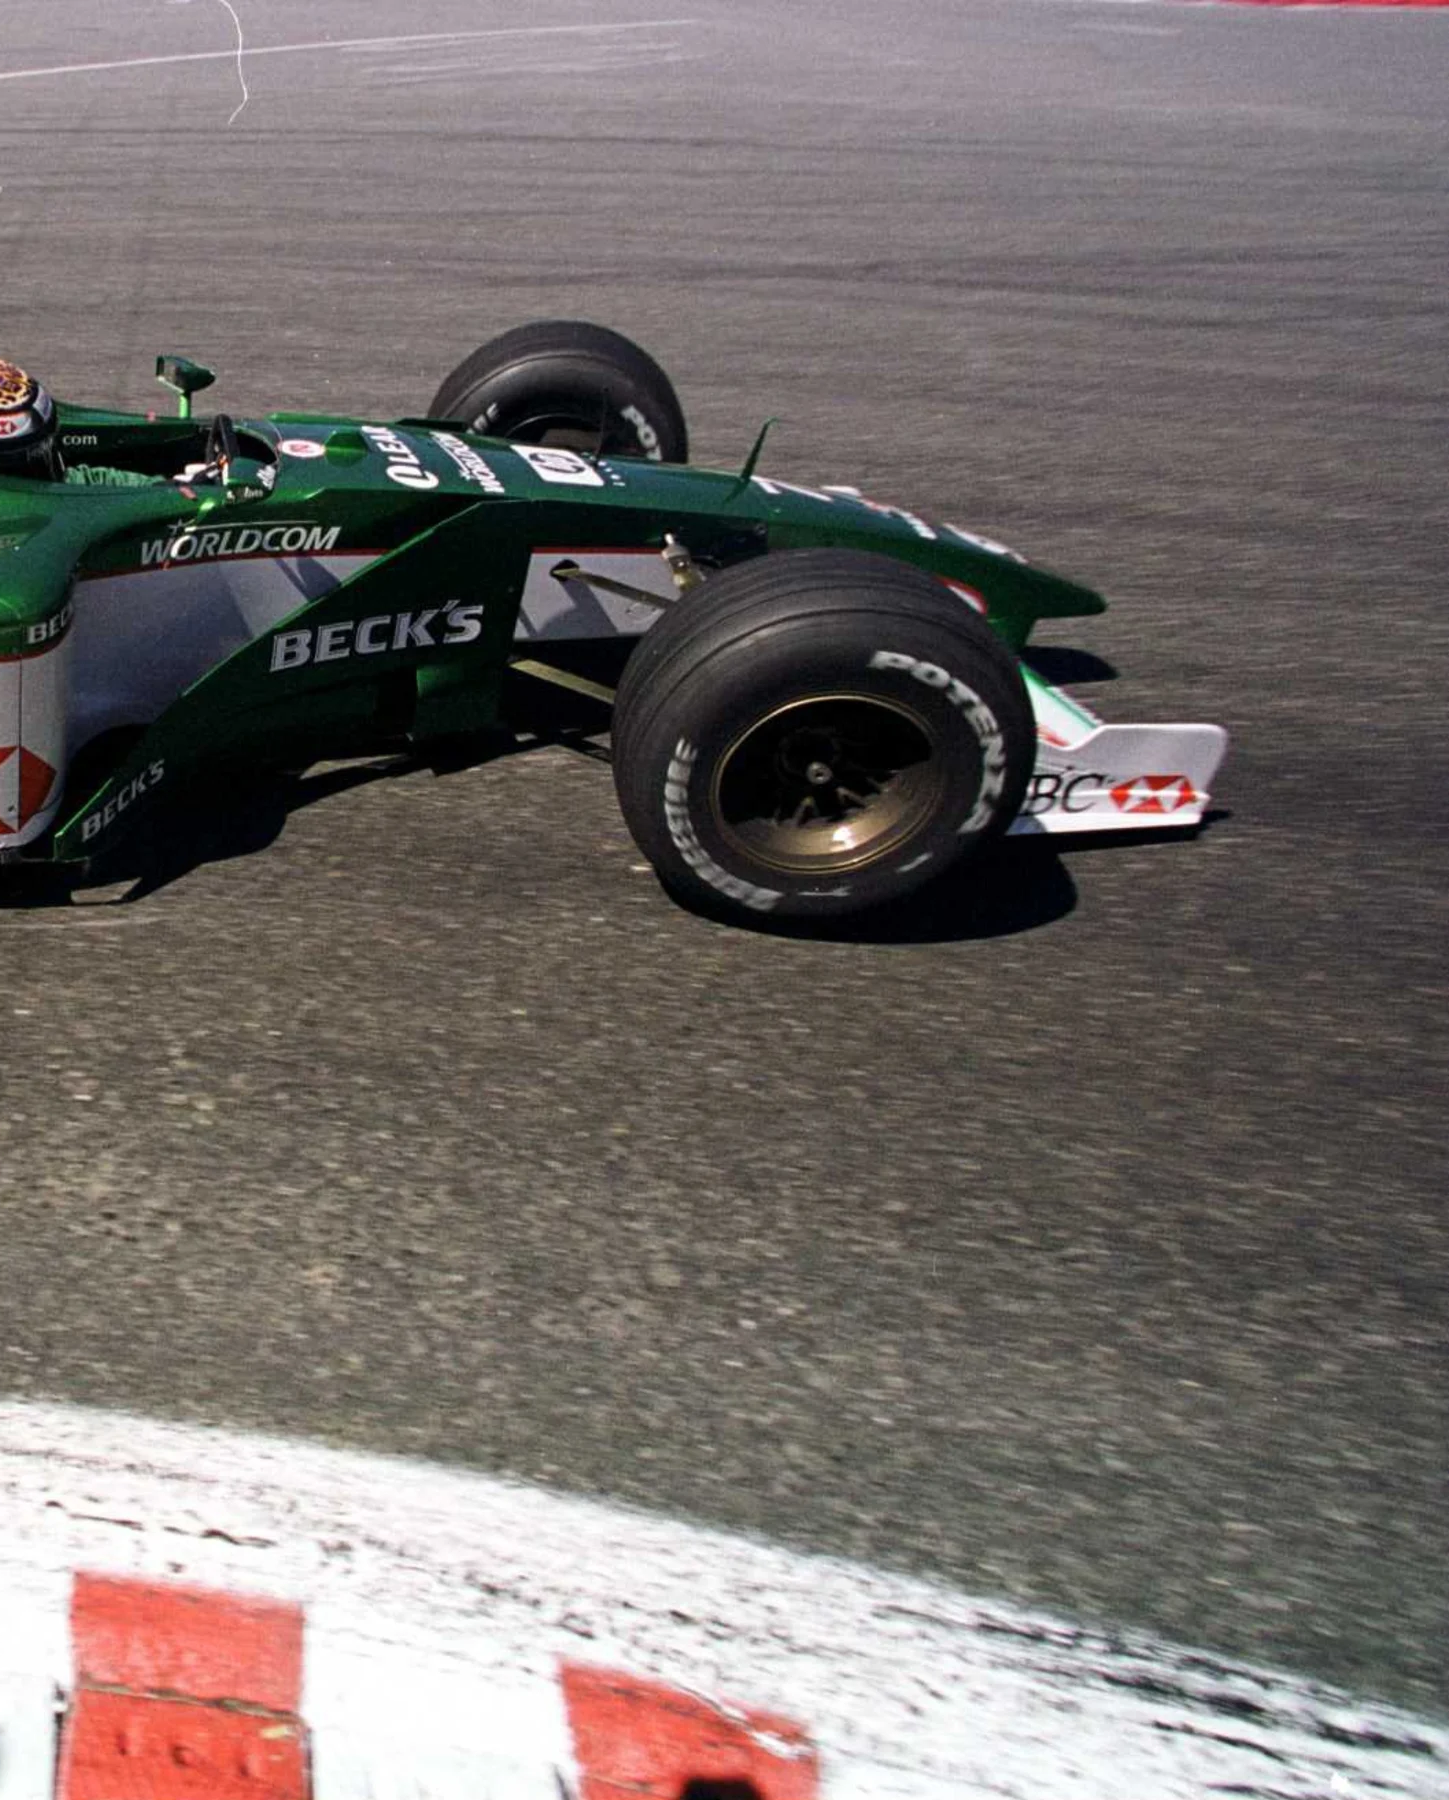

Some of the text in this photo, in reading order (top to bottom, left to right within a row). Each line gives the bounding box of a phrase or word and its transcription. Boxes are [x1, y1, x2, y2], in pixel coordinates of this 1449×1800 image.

[63, 434, 98, 446] com
[141, 524, 341, 566] WORLDCOM
[269, 600, 484, 673] BECK'S
[82, 758, 164, 843] BECK'S
